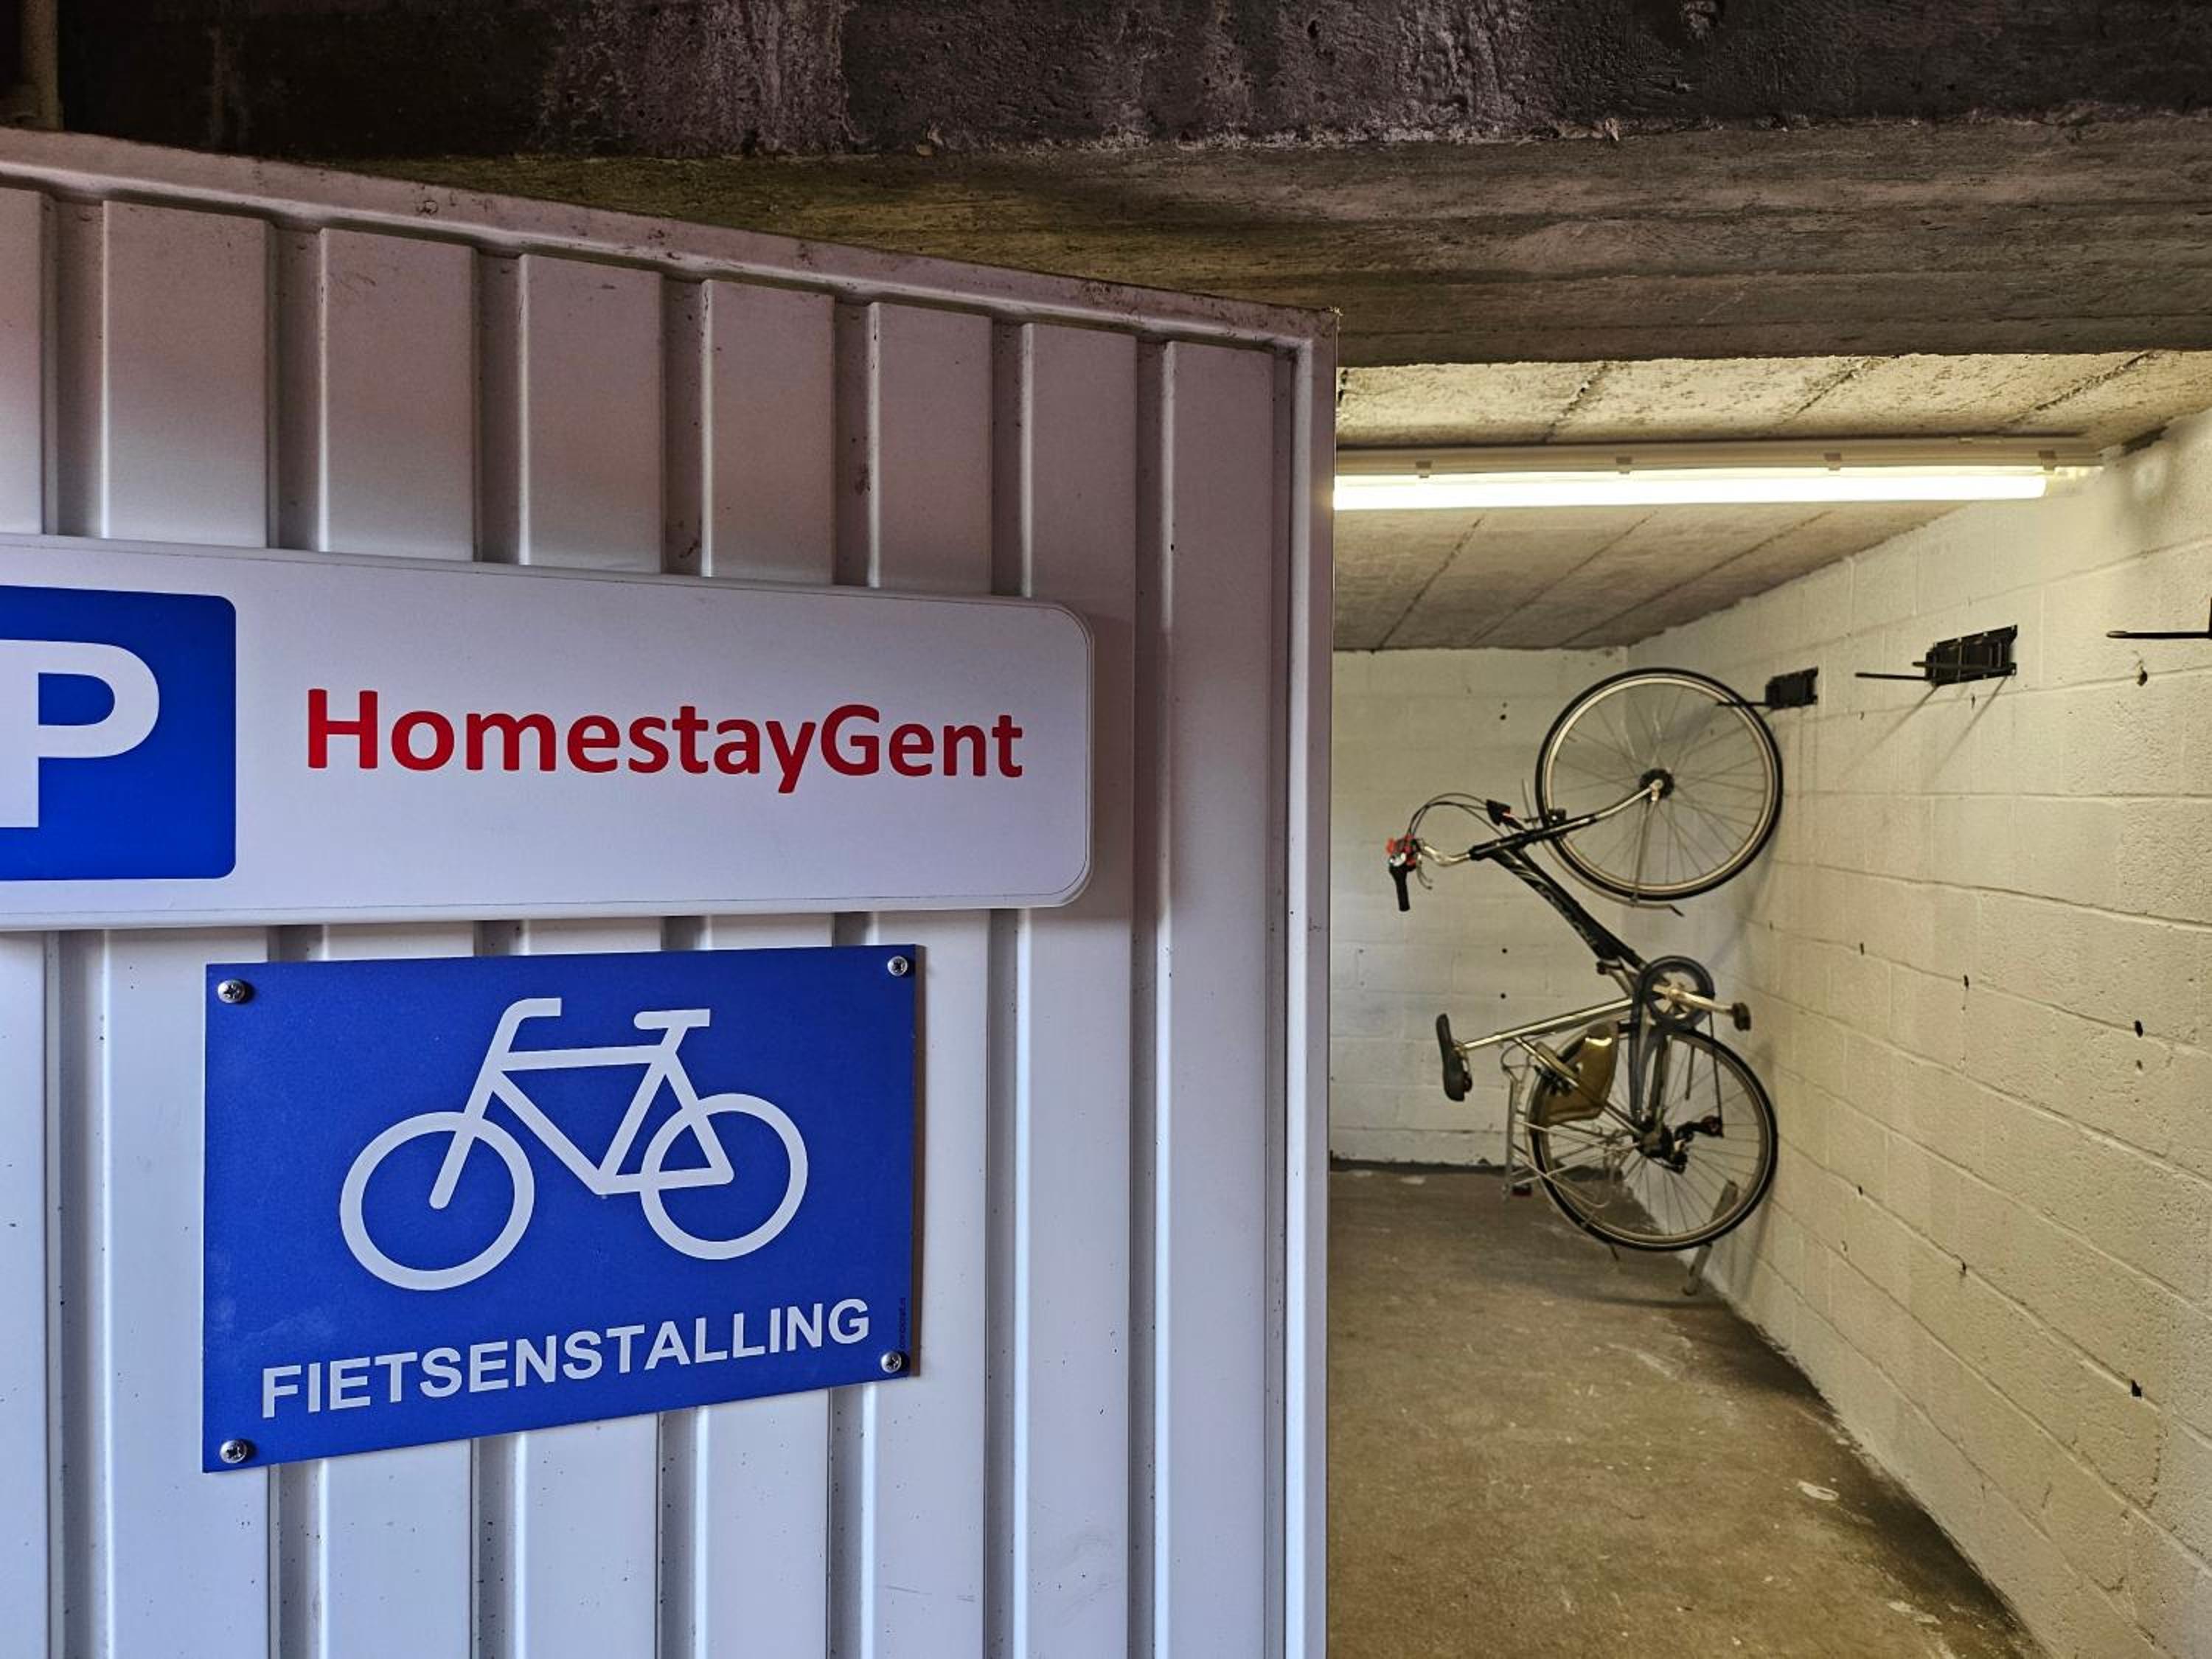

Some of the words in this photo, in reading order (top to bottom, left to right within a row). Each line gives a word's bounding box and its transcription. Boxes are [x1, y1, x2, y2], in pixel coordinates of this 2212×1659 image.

[0, 639, 160, 828] P
[307, 689, 1023, 793] HomestayGent
[262, 1298, 870, 1419] FIETSENSTALLING
